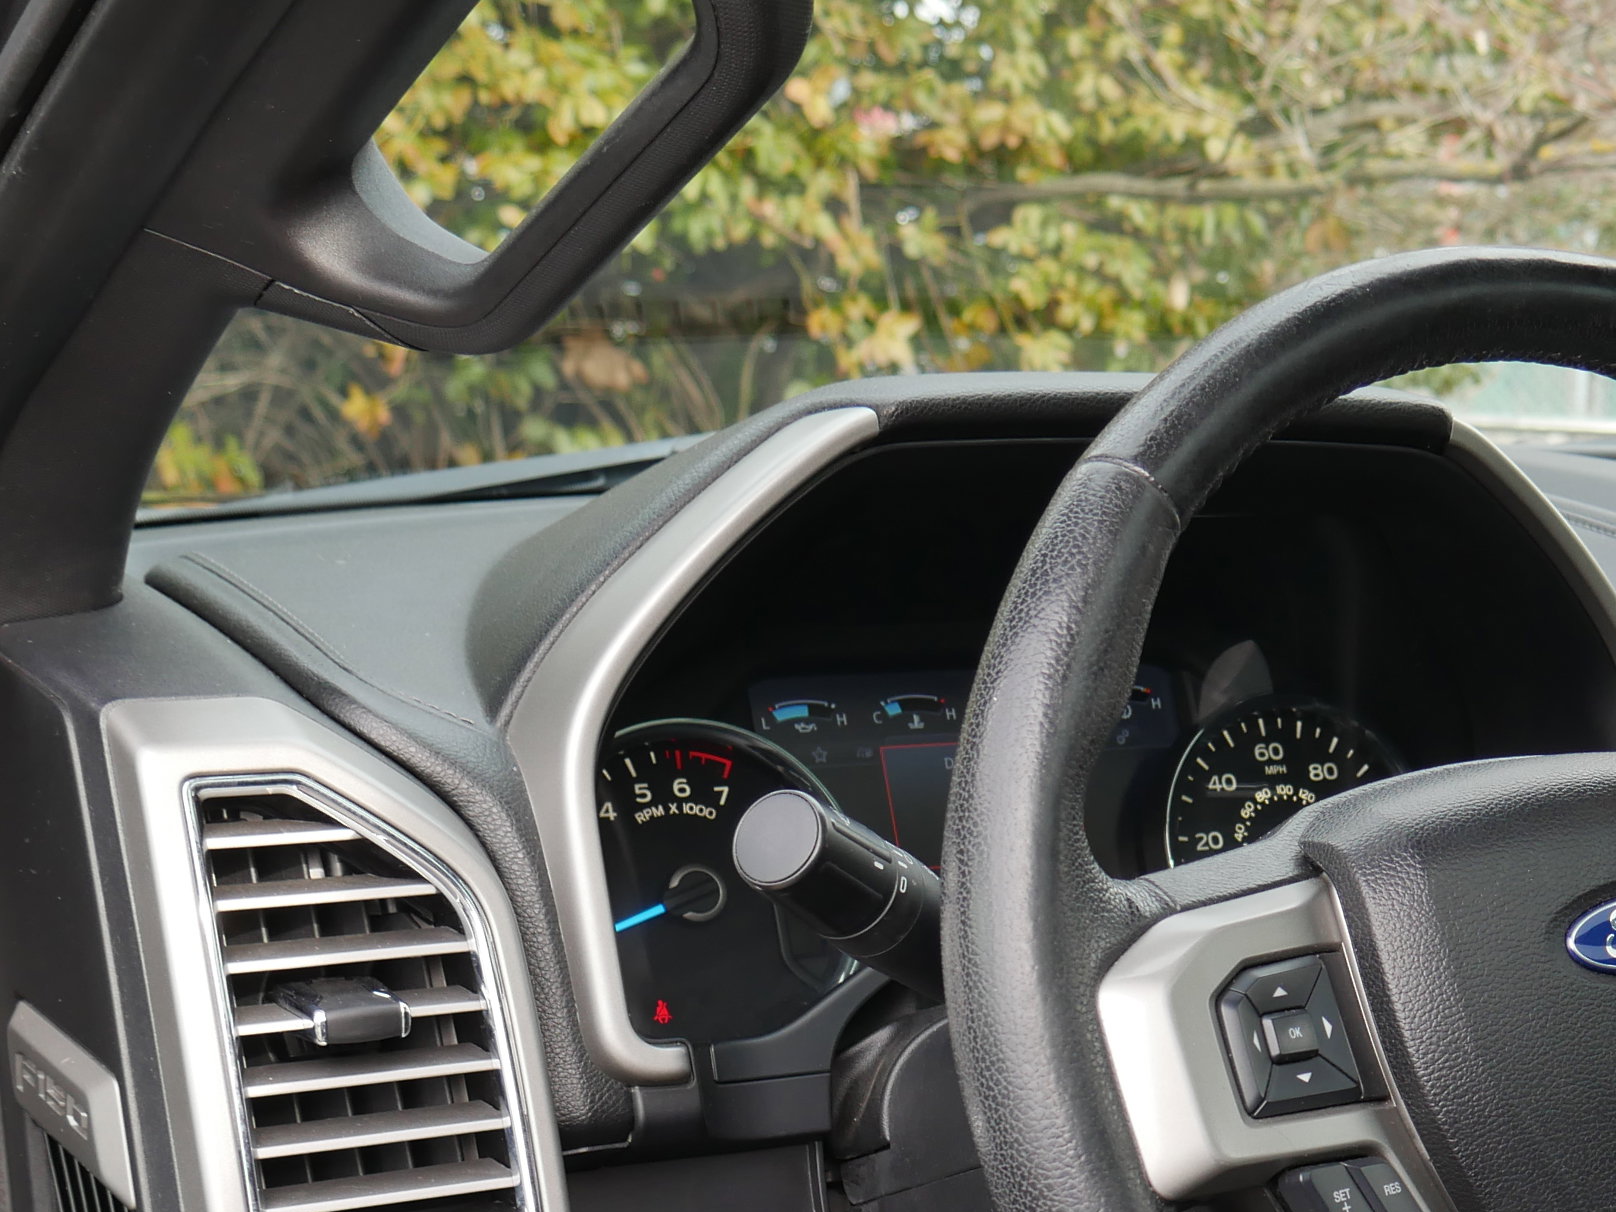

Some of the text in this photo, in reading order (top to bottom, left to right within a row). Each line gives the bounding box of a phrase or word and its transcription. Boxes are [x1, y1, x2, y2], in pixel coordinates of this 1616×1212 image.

[837, 714, 847, 726] H
[873, 711, 883, 724] C
[946, 709, 956, 720] H
[1254, 742, 1284, 761] 60
[1265, 764, 1287, 775] MPH
[1308, 762, 1338, 781] 80
[672, 778, 691, 798] 6
[1208, 774, 1237, 792] 40
[1276, 784, 1293, 796] 100
[634, 783, 652, 803] 5
[713, 786, 729, 805] 7
[1254, 788, 1271, 802] 80
[1298, 788, 1315, 803] 120
[599, 802, 617, 821] 4
[634, 804, 665, 824] RPM
[683, 802, 716, 820] 1000
[1240, 801, 1254, 819] 60
[1195, 832, 1224, 851] 20
[1234, 823, 1245, 842] 40
[1288, 1027, 1303, 1039] OK
[1333, 1188, 1351, 1203] SET
[1383, 1182, 1402, 1196] RES
